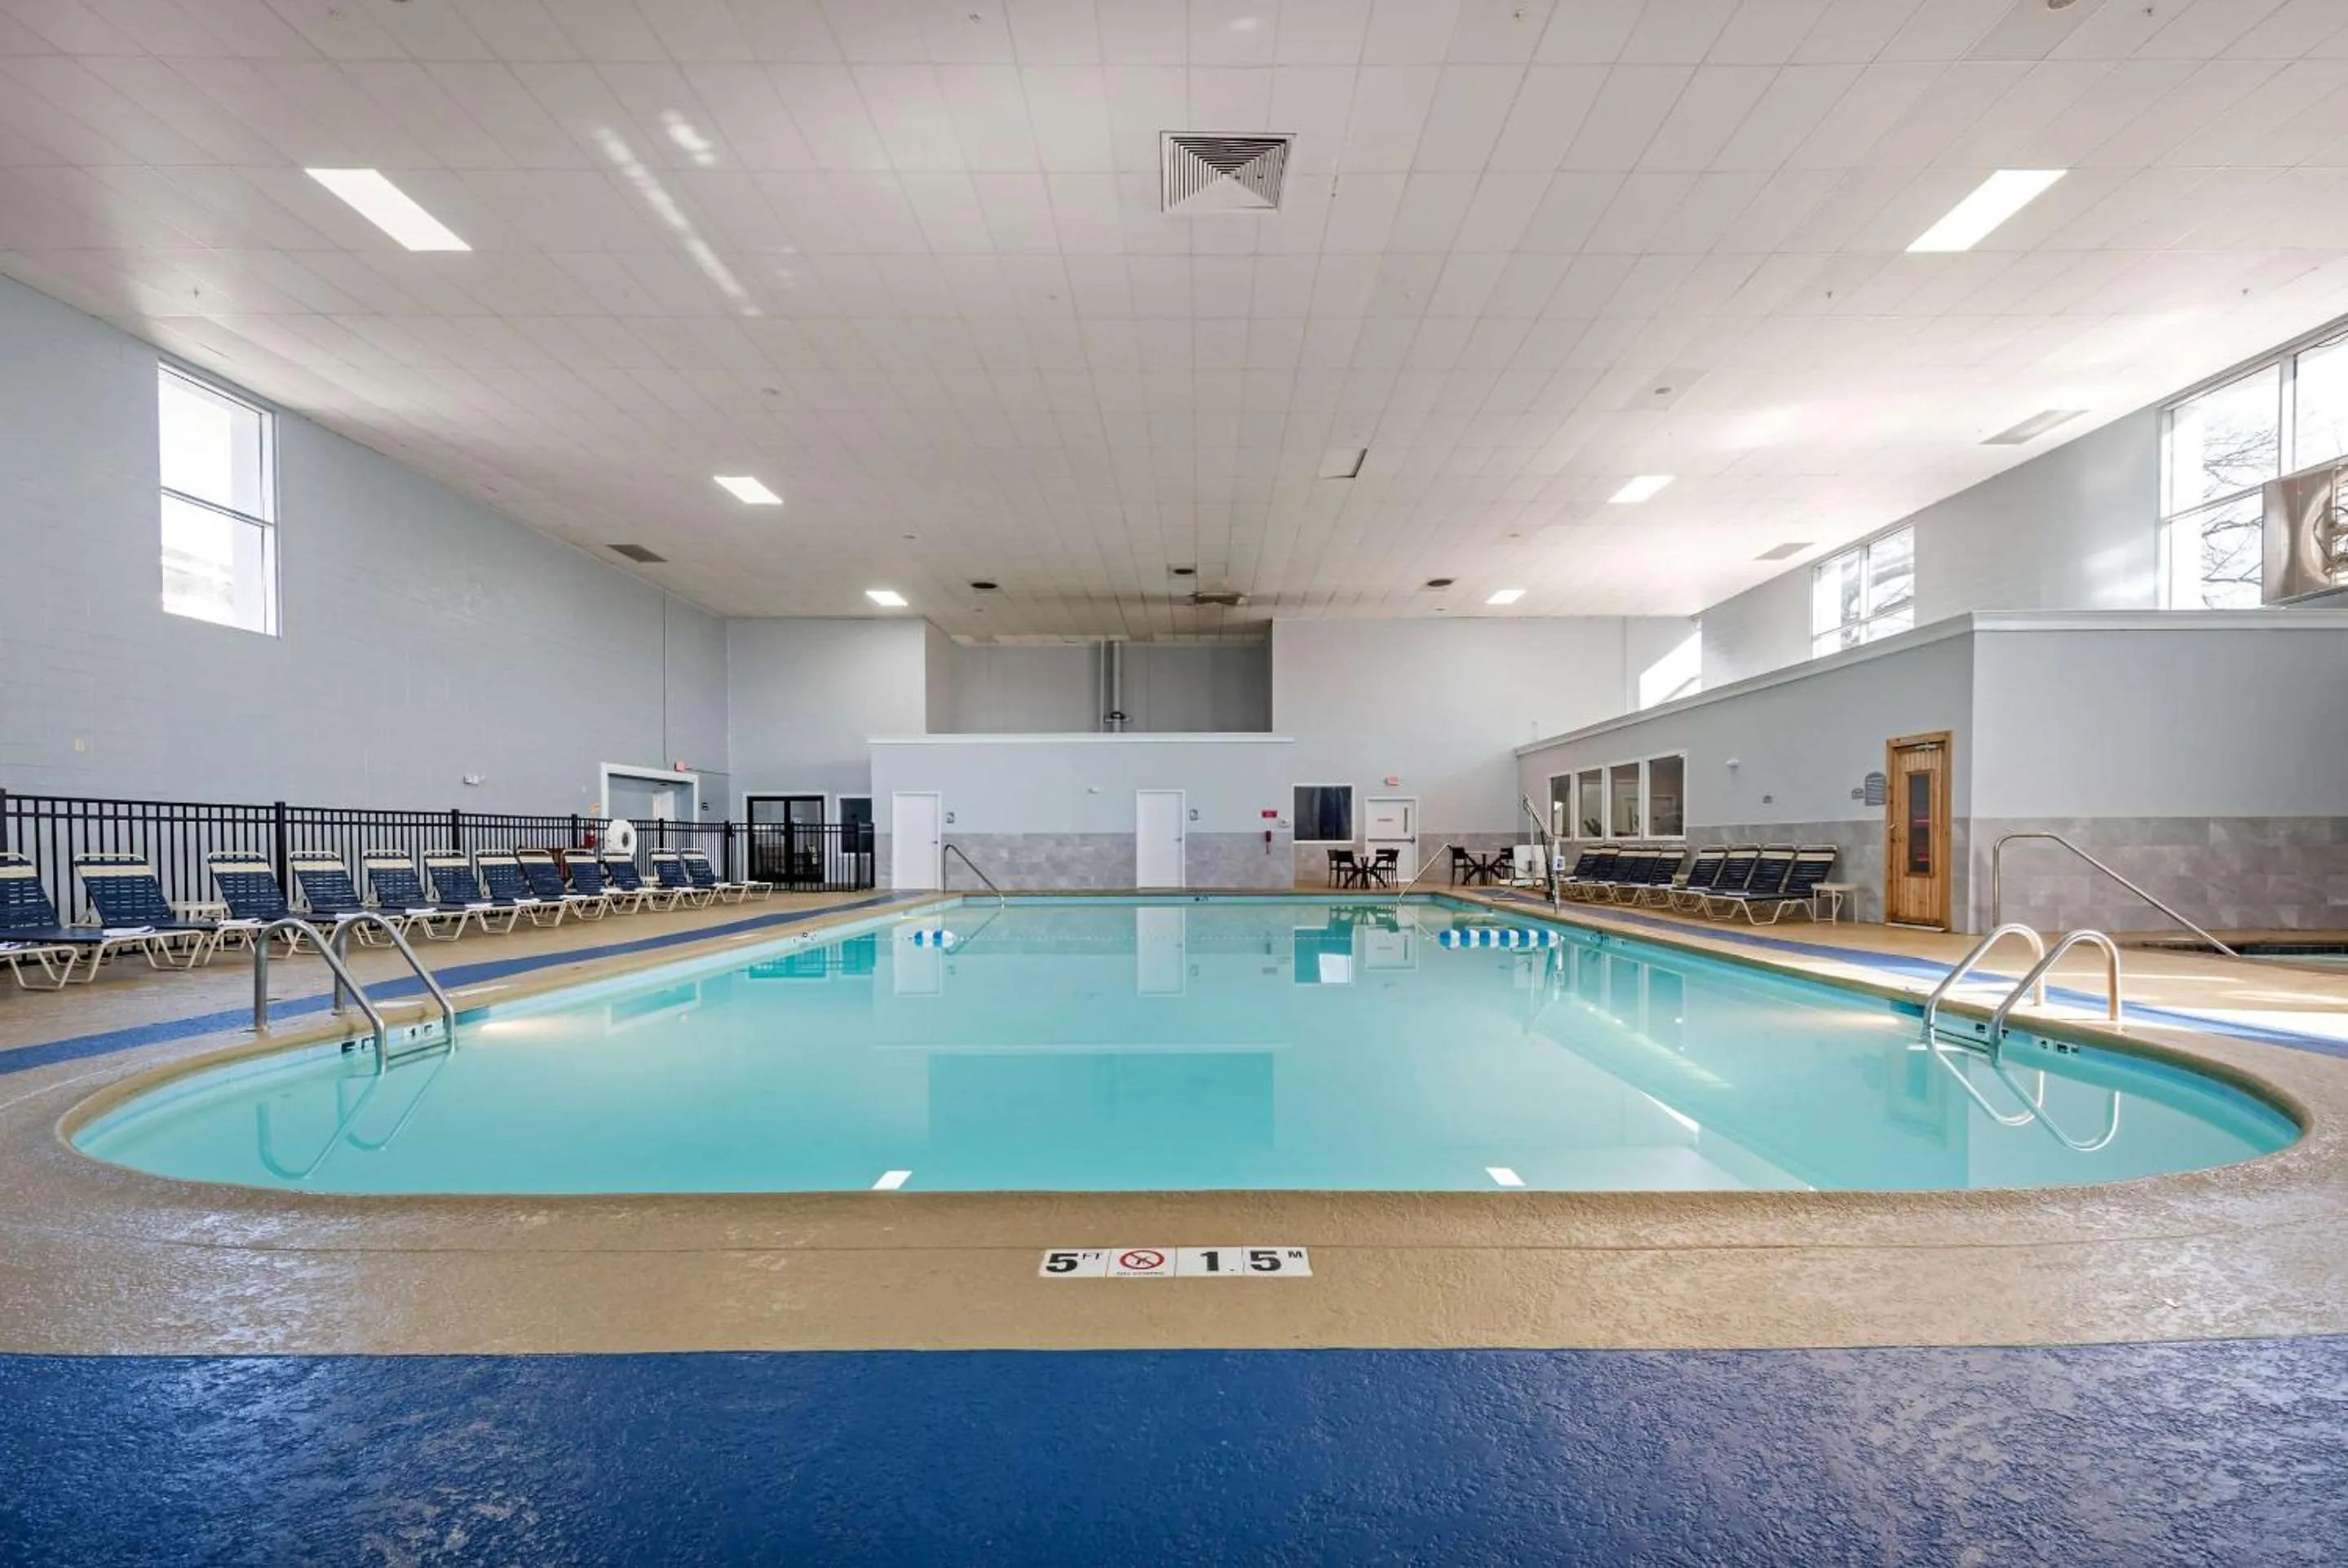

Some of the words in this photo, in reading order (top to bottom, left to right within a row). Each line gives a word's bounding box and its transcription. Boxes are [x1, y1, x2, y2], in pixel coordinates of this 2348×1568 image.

[1046, 1252, 1078, 1273] 5
[1081, 1252, 1103, 1261] FT
[1287, 1250, 1303, 1258] M
